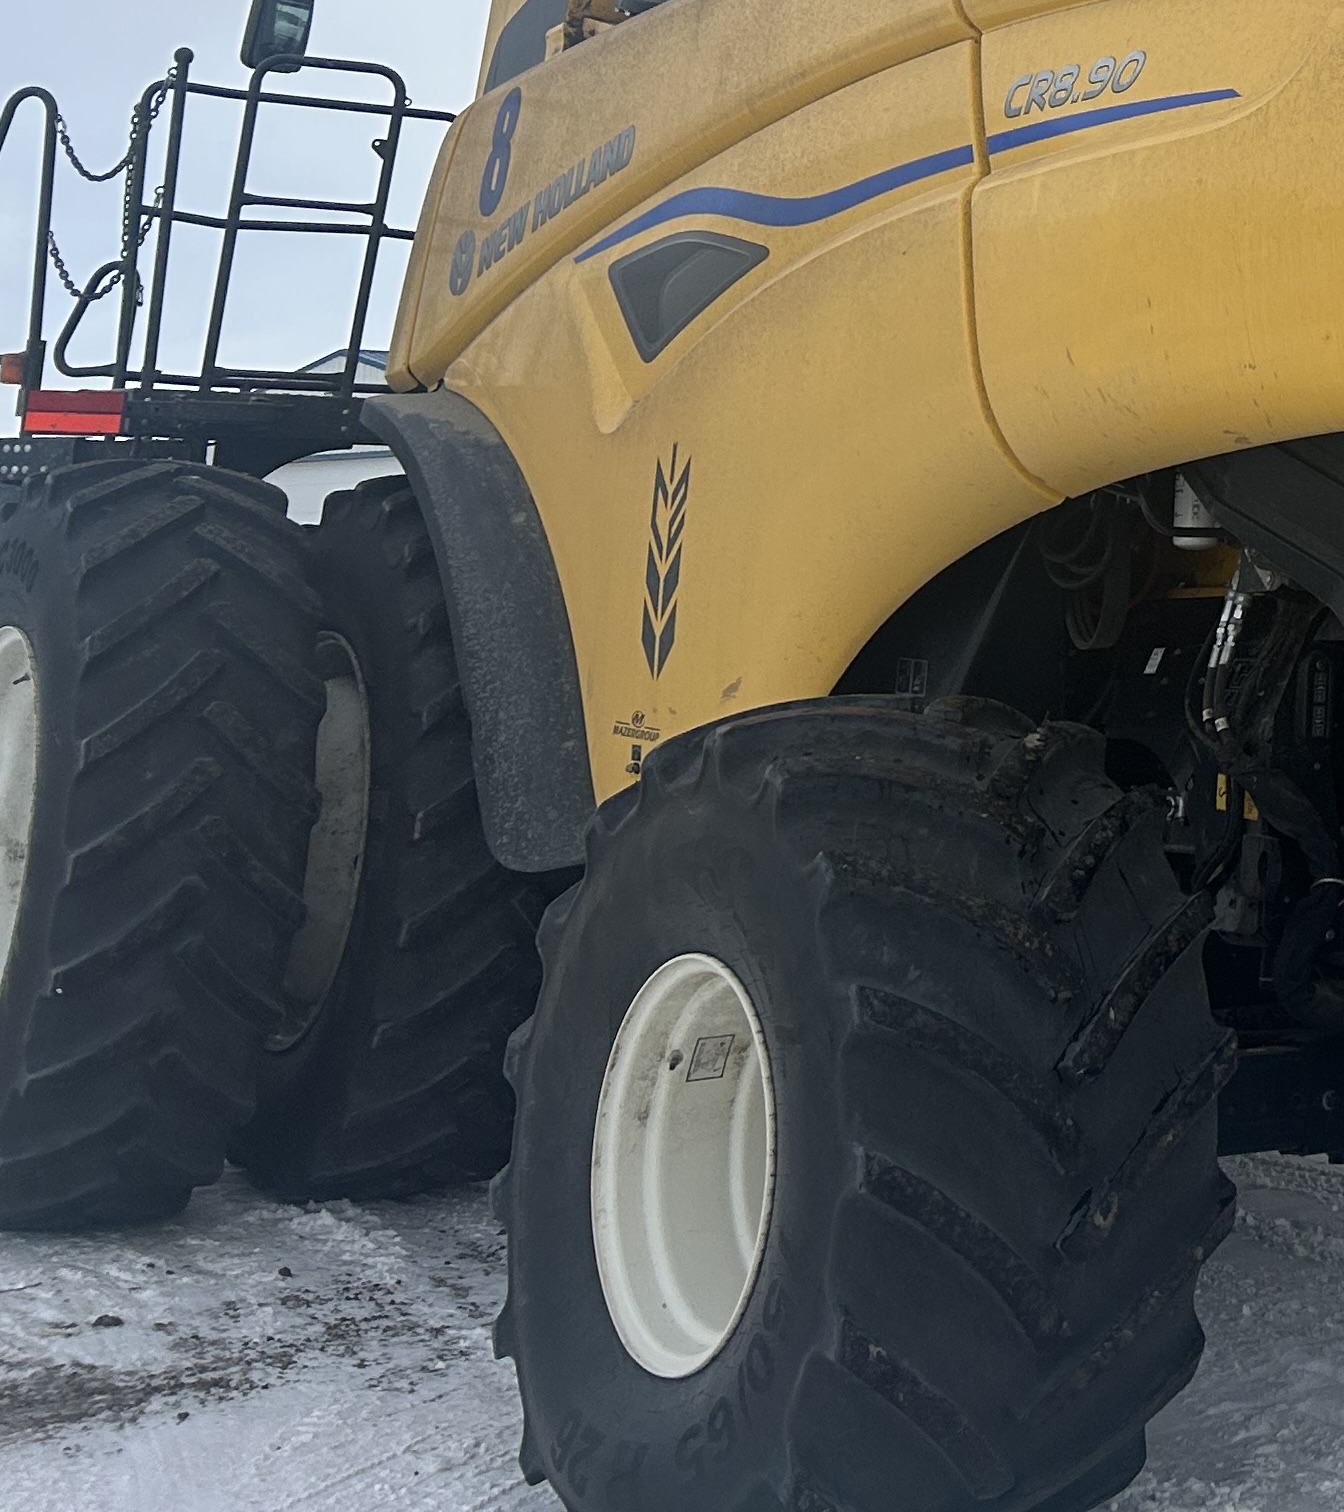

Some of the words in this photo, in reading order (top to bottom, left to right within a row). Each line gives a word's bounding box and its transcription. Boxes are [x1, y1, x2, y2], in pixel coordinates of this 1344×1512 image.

[1004, 50, 1147, 118] CR8.90
[476, 200, 531, 278] NEW
[531, 124, 636, 233] HOLLAND
[479, 86, 521, 217] 8
